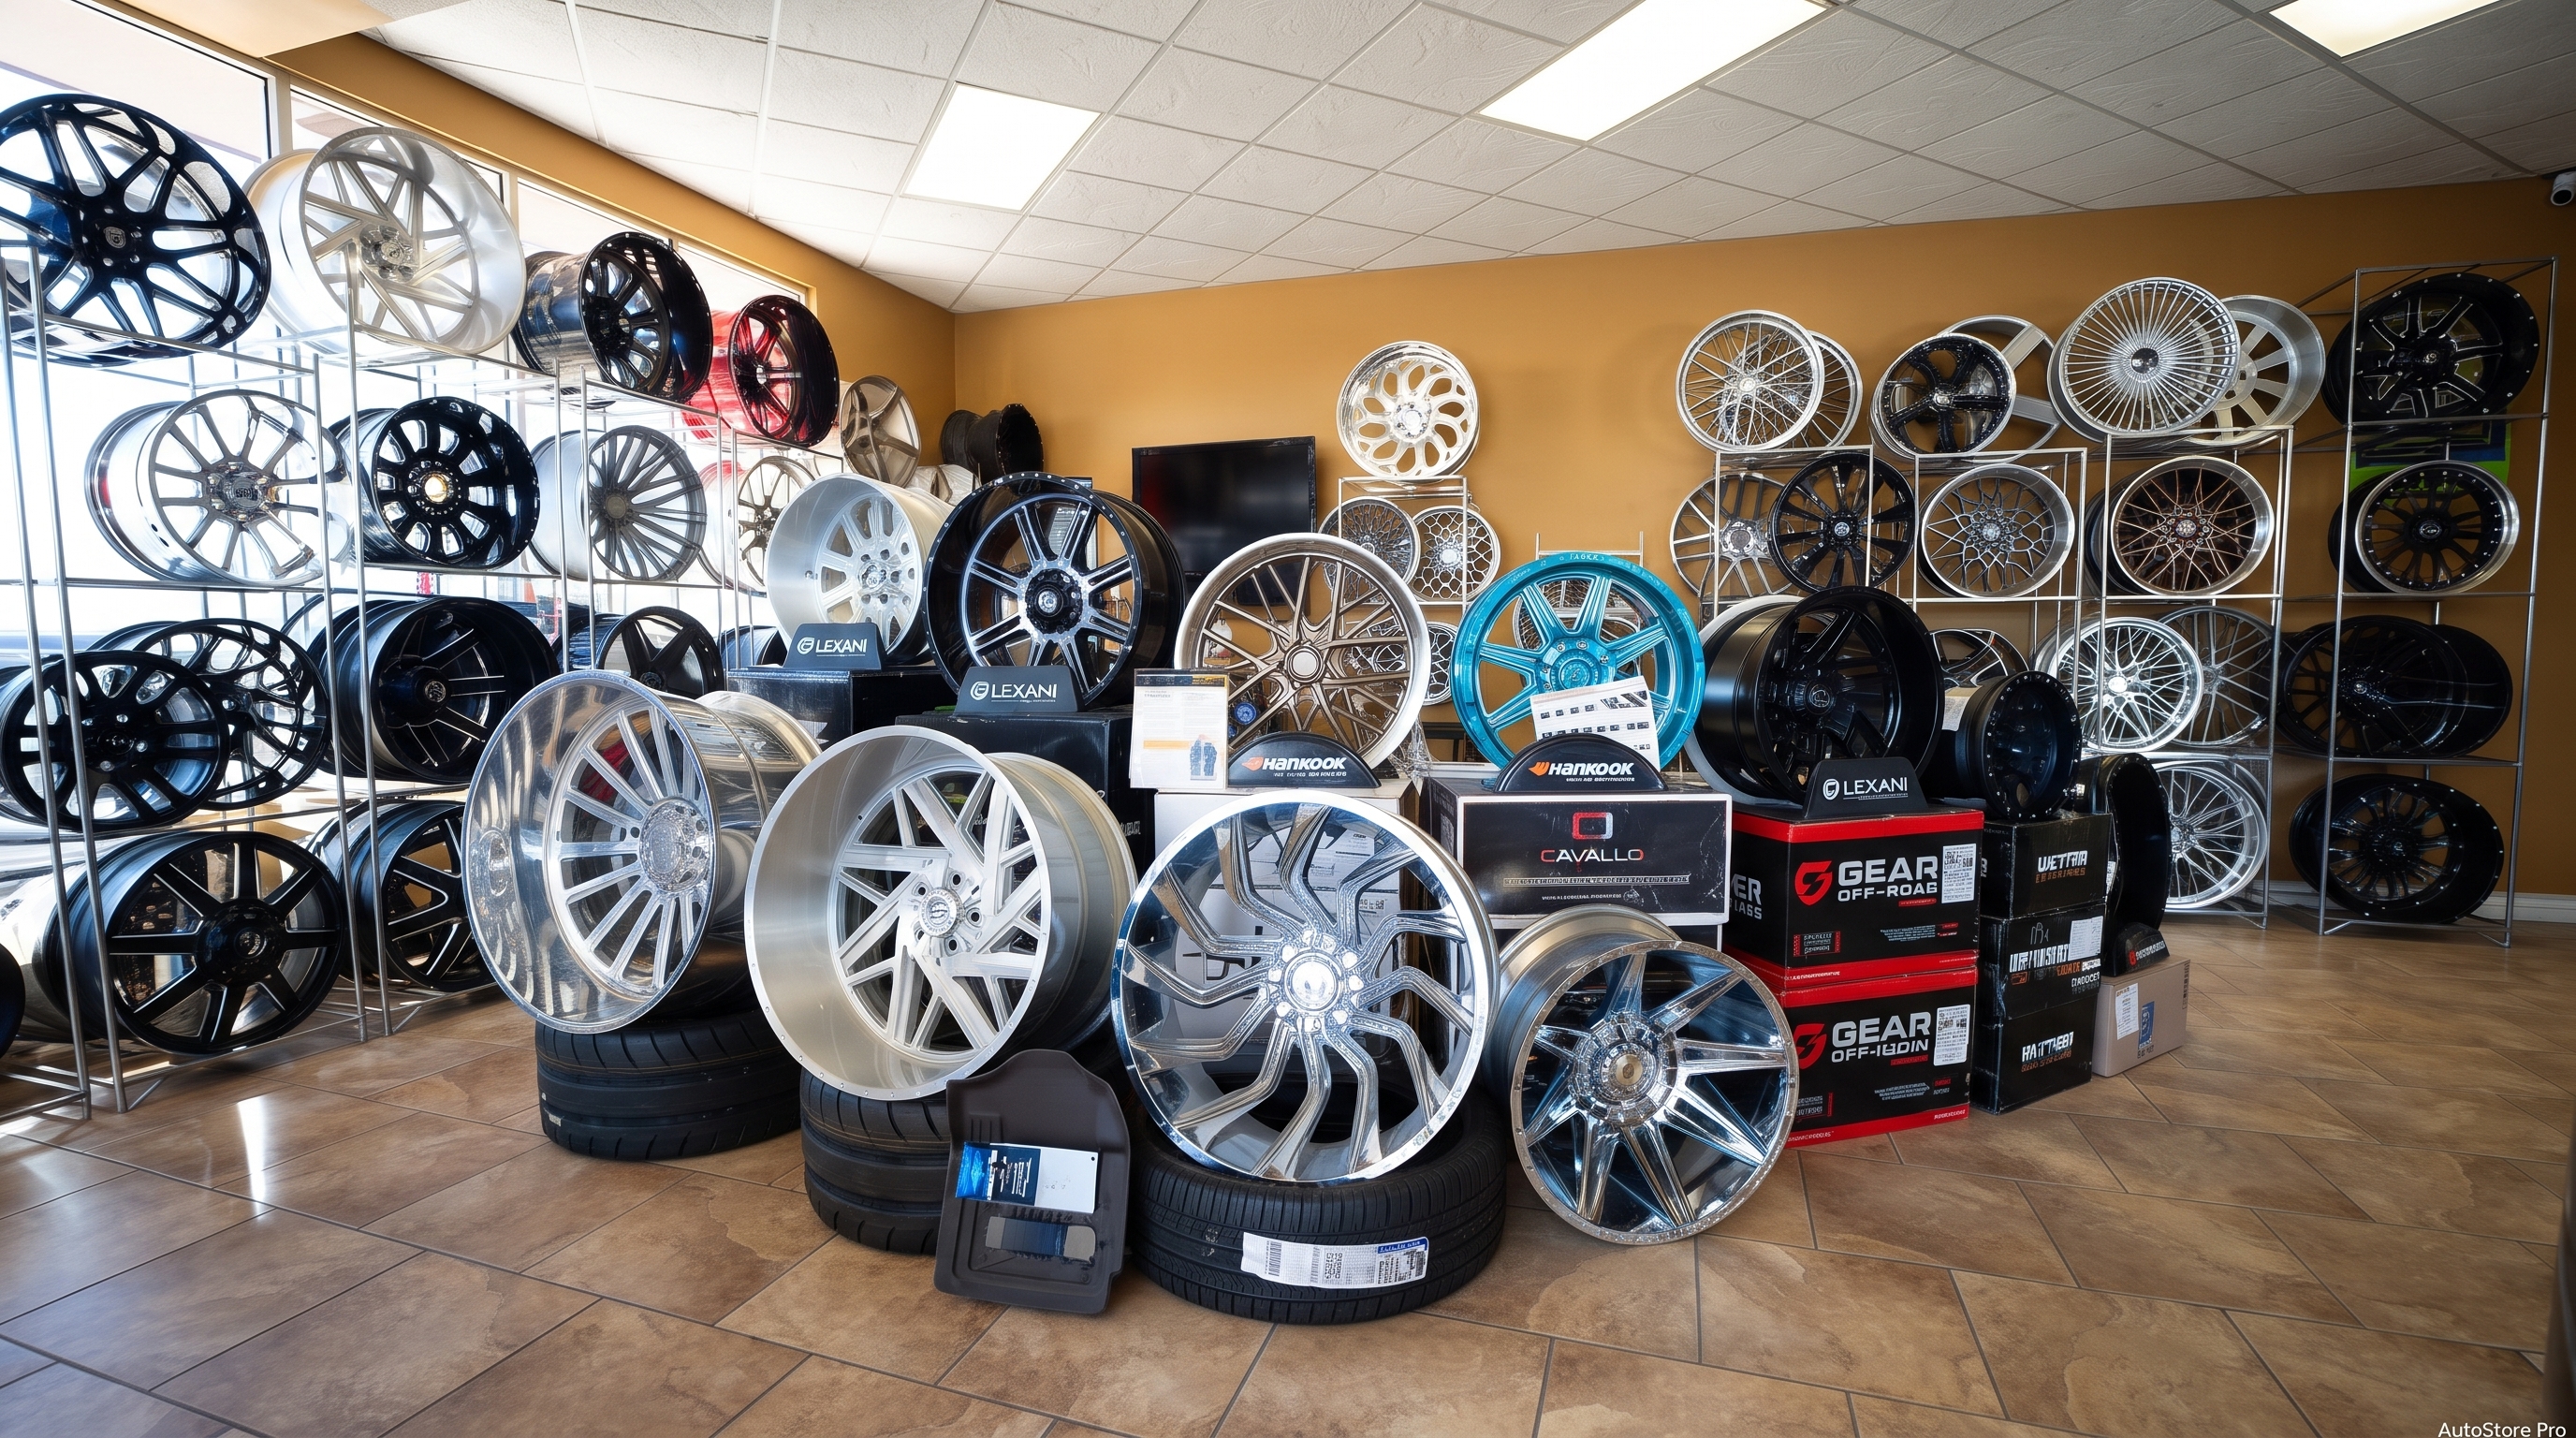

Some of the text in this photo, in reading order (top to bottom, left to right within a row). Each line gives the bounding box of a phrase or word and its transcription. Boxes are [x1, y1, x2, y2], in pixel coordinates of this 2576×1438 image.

[815, 638, 867, 653] LEXANI
[991, 683, 1057, 698] LEXANI
[1843, 777, 1908, 796] LEXANI
[1541, 848, 1645, 862] CAVALLO
[1837, 856, 1939, 887] GEAR
[1832, 1011, 1931, 1048] GEAR
